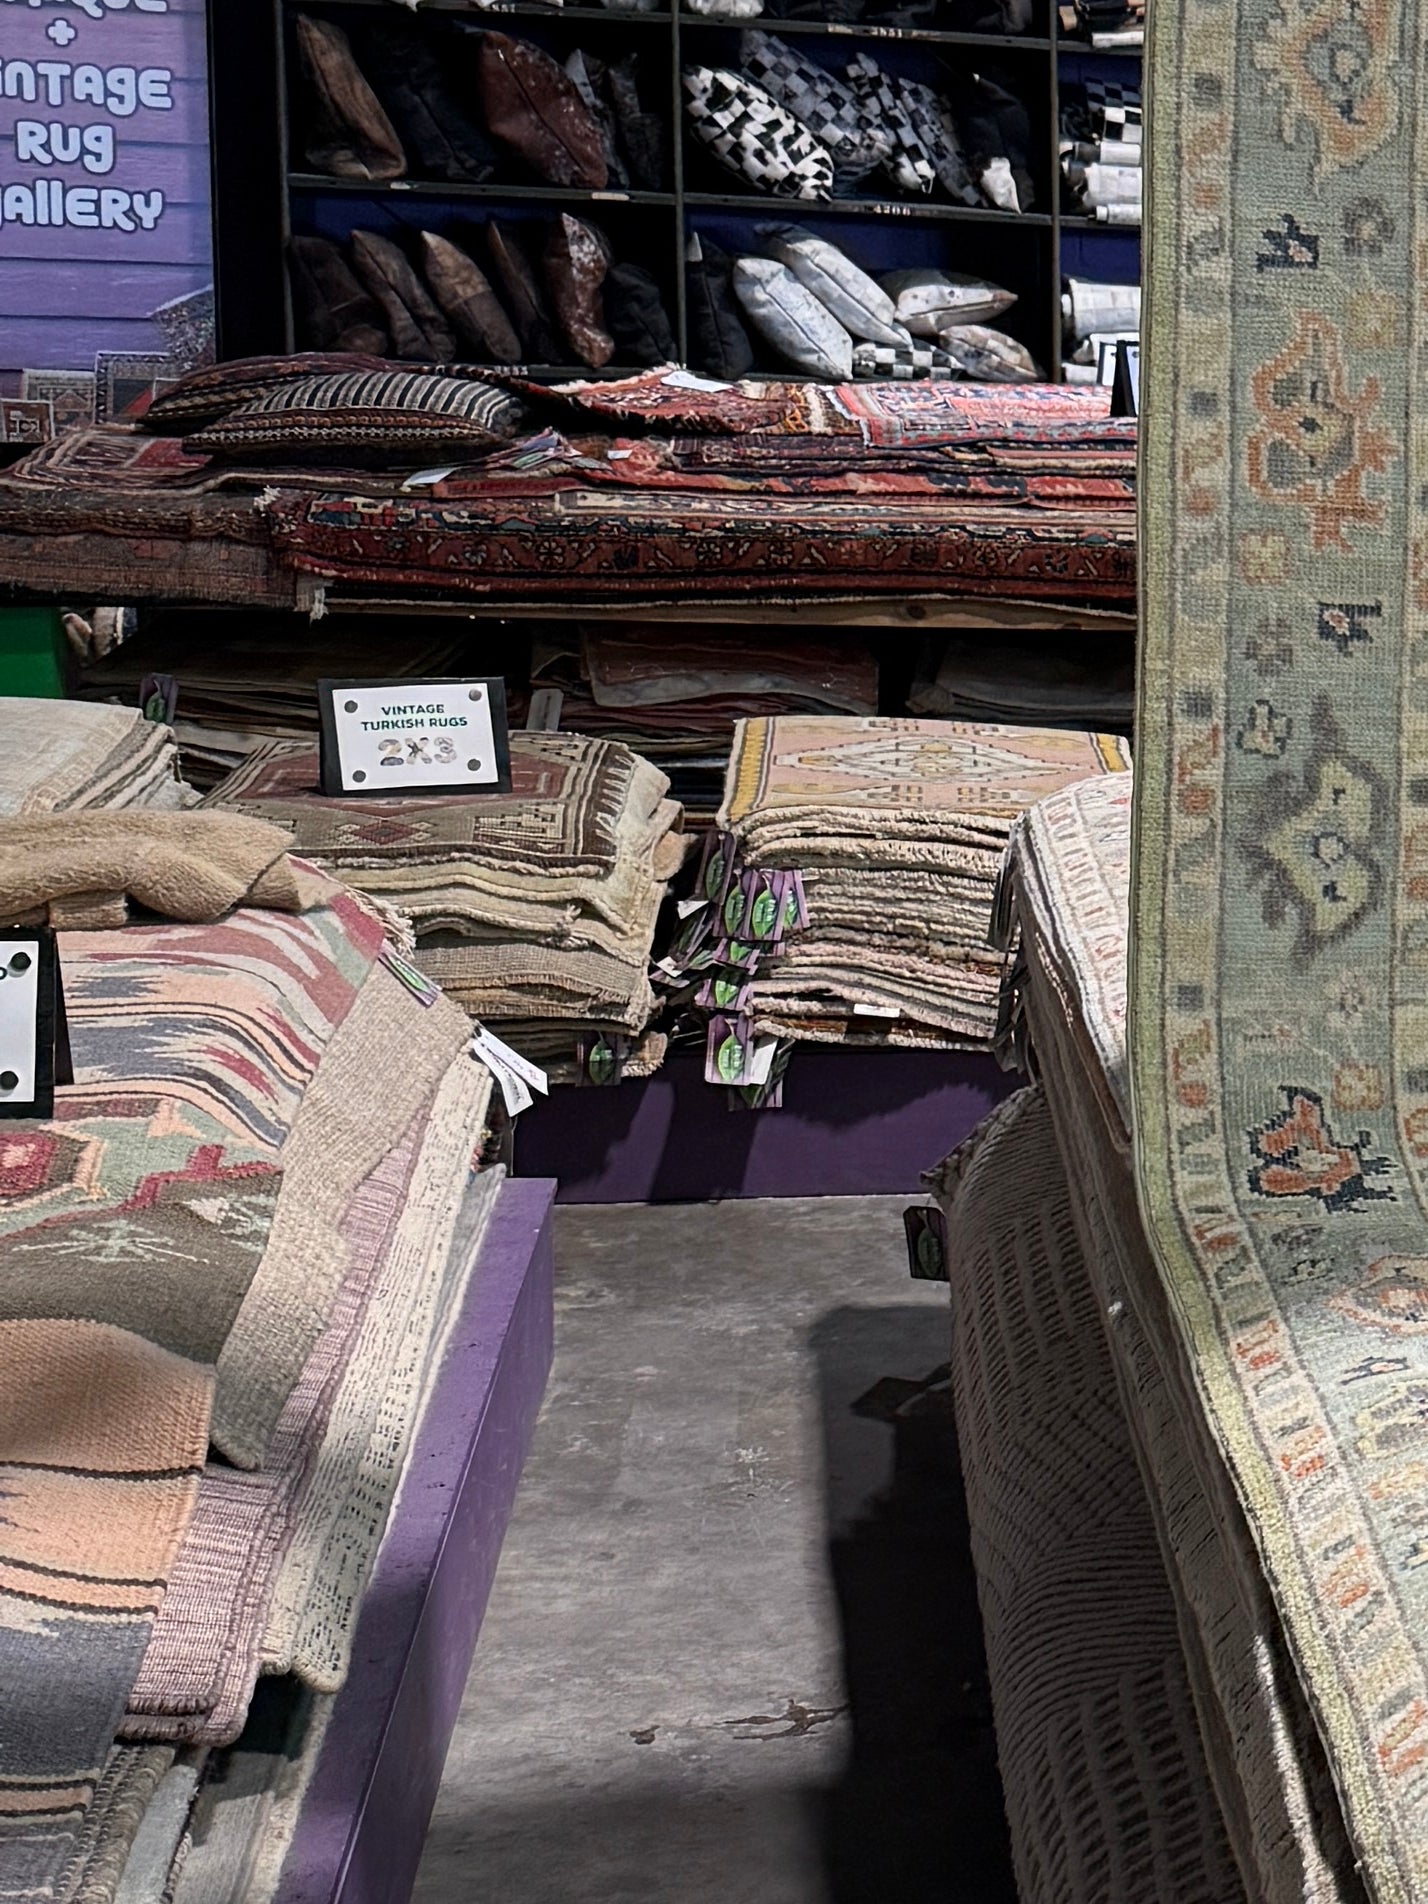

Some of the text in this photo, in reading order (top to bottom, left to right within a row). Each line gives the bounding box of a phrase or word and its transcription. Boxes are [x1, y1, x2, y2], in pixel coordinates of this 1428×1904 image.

[0, 59, 172, 116] nTAgE
[381, 704, 445, 715] VINTAGE
[361, 716, 468, 731] TURKISH RUGS
[377, 736, 458, 766] 2X3
